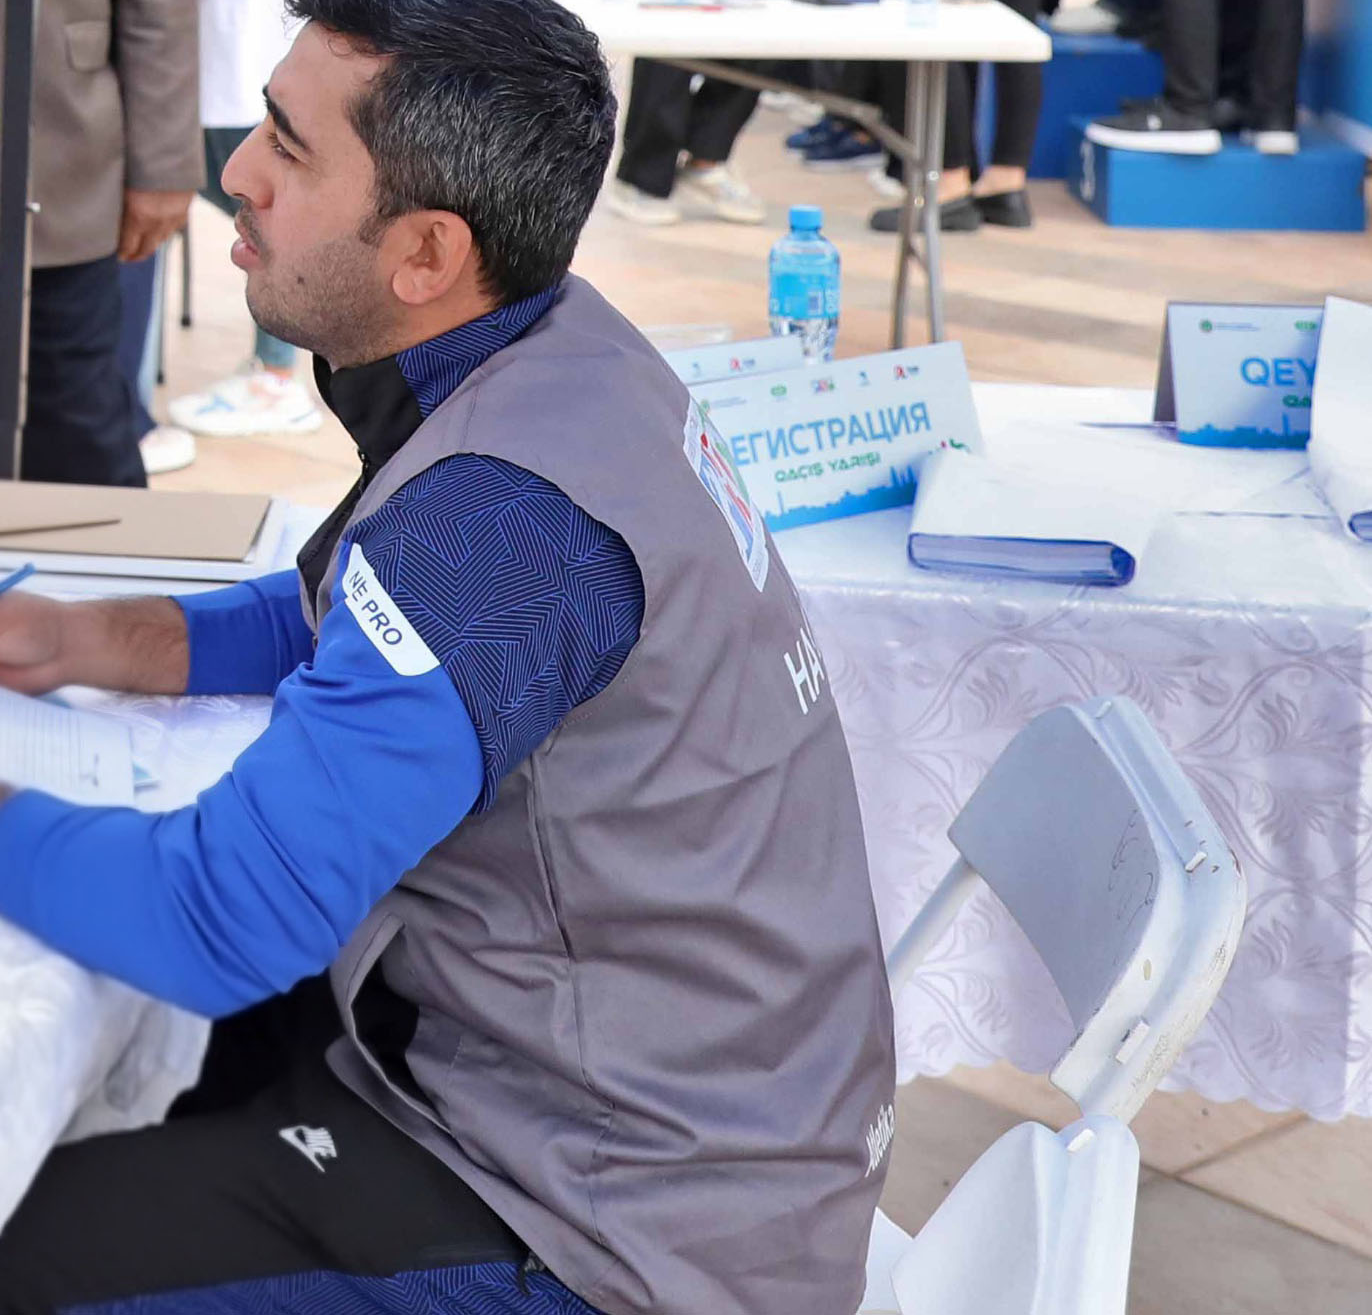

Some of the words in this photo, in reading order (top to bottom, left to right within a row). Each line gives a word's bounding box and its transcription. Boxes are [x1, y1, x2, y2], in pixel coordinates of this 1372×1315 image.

[1240, 356, 1316, 387] QEY
[727, 401, 933, 466] ЕГИСТРАЦИЯ
[361, 599, 403, 645] PRO
[783, 627, 826, 715] HA
